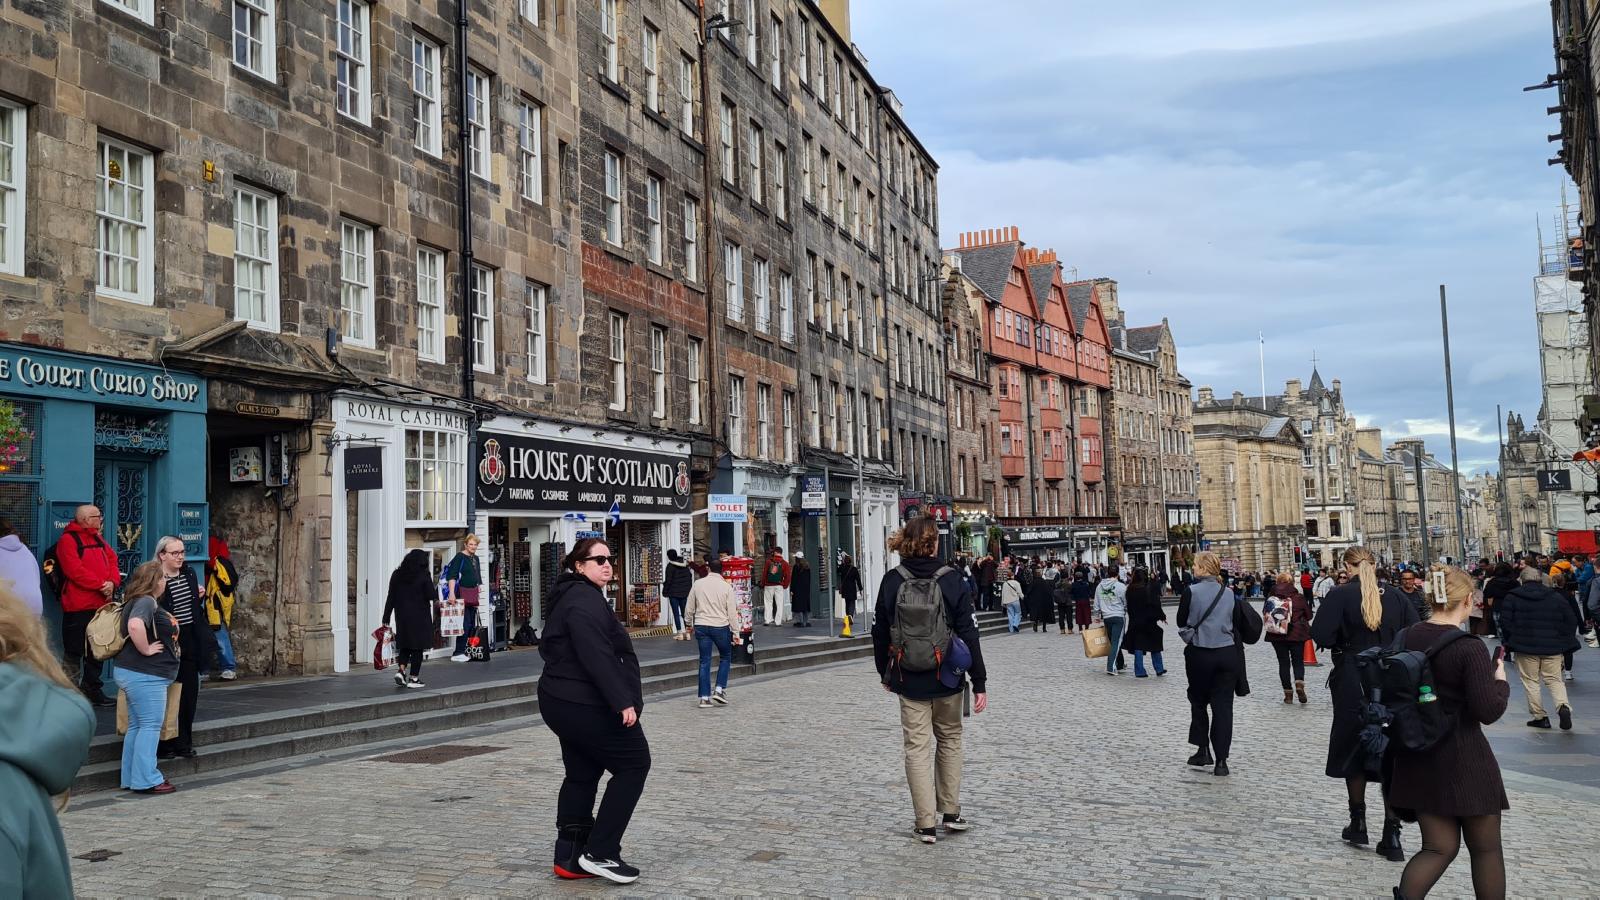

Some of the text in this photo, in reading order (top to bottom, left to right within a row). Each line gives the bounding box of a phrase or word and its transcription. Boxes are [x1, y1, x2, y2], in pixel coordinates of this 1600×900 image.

[16, 357, 84, 388] COURT
[90, 366, 147, 395] CURIO
[151, 374, 198, 400] SHOP
[260, 406, 278, 415] COURT
[348, 401, 468, 431] ROYAL CASHMERE
[509, 446, 674, 489] HOUSE OF SCOTLAND
[1548, 472, 1560, 484] K
[509, 488, 534, 500] TARTANS
[541, 490, 569, 501] CASHMERE
[715, 504, 743, 512] TO LET
